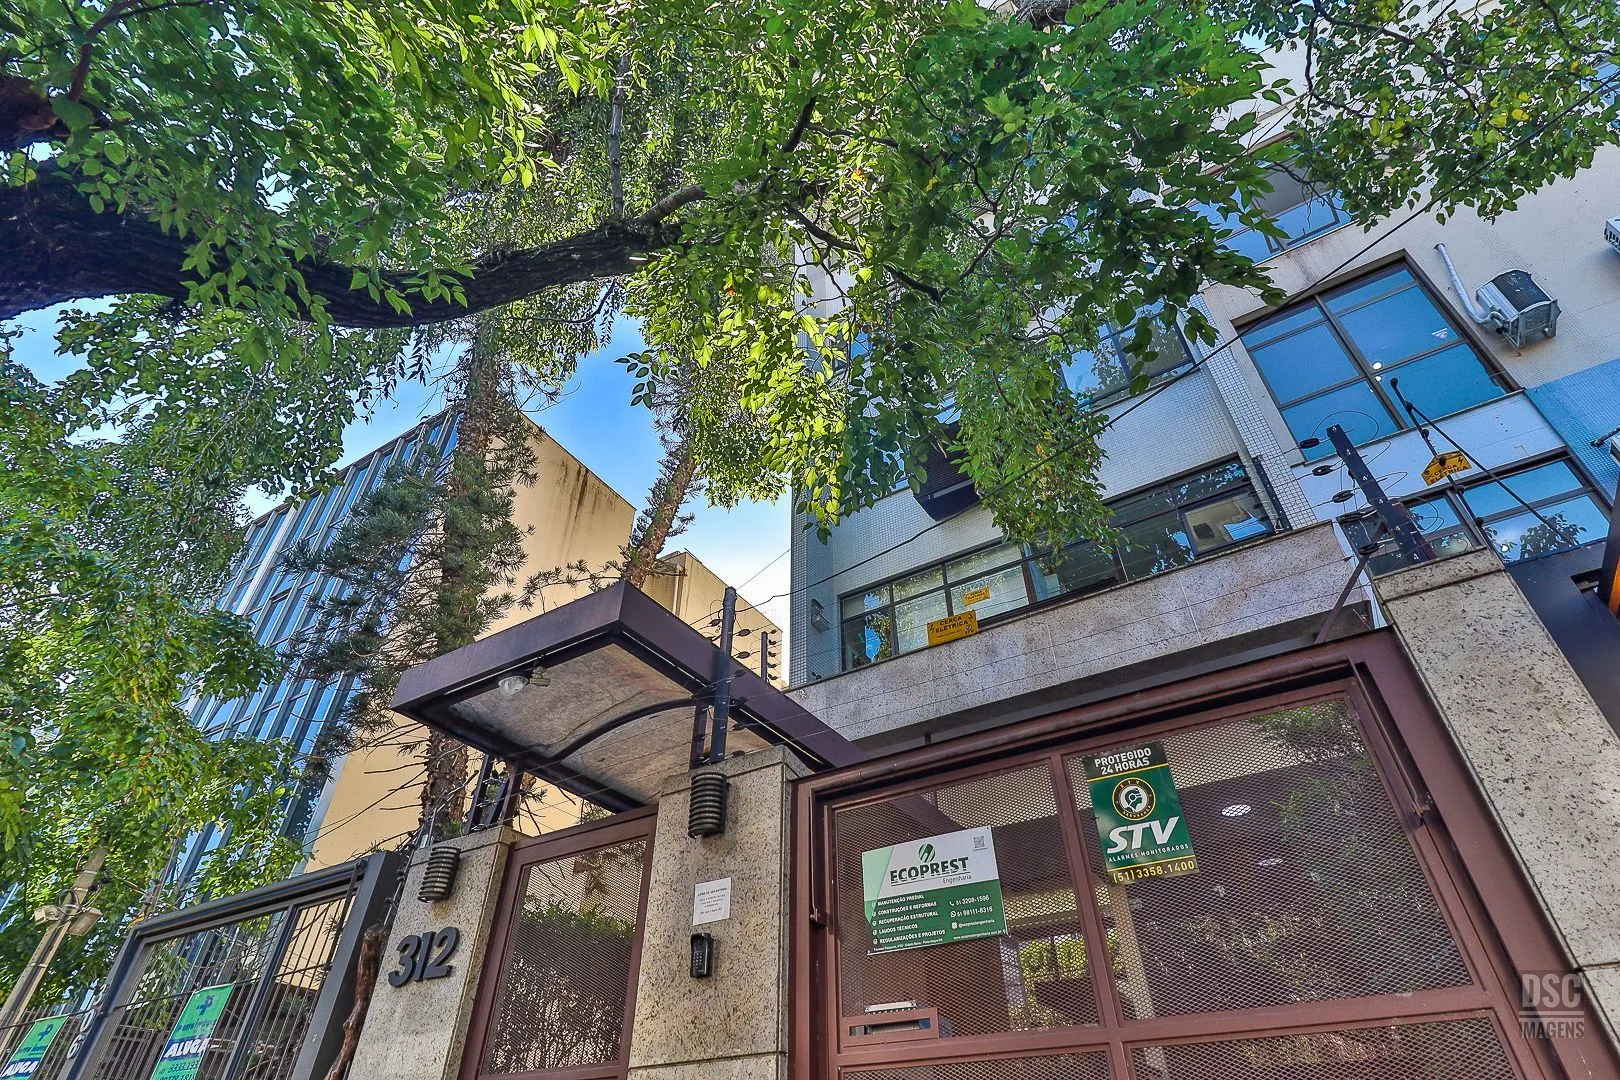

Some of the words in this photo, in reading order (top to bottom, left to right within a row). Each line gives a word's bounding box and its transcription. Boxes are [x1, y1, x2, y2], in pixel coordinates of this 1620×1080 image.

[940, 616, 962, 626] CERCA
[1094, 747, 1151, 767] PROTEGIDO
[1100, 766, 1114, 775] 24
[1115, 757, 1150, 772] HORAS
[1106, 816, 1180, 854] STV
[1108, 851, 1139, 863] ALARMES
[1140, 843, 1189, 857] MONITORADOS
[889, 856, 969, 884] ECOPREST
[942, 873, 972, 885] Engenharia
[1113, 860, 1195, 883] (51)3358.1400
[877, 895, 906, 907] MANUTENÇÃO
[878, 906, 908, 915] CONSTRUÇÕES
[913, 901, 937, 909] REFORMAS
[878, 915, 909, 925] RECUPERAÇÃO
[910, 911, 938, 919] ESTRUTURAL
[879, 926, 896, 934] LAUDOS
[896, 923, 918, 931] TÉCNICOS
[879, 933, 918, 944] REGULARIZAÇÕES
[922, 930, 946, 938] PROJETOS
[388, 926, 460, 987] 312
[163, 1038, 210, 1058] ALUGA
